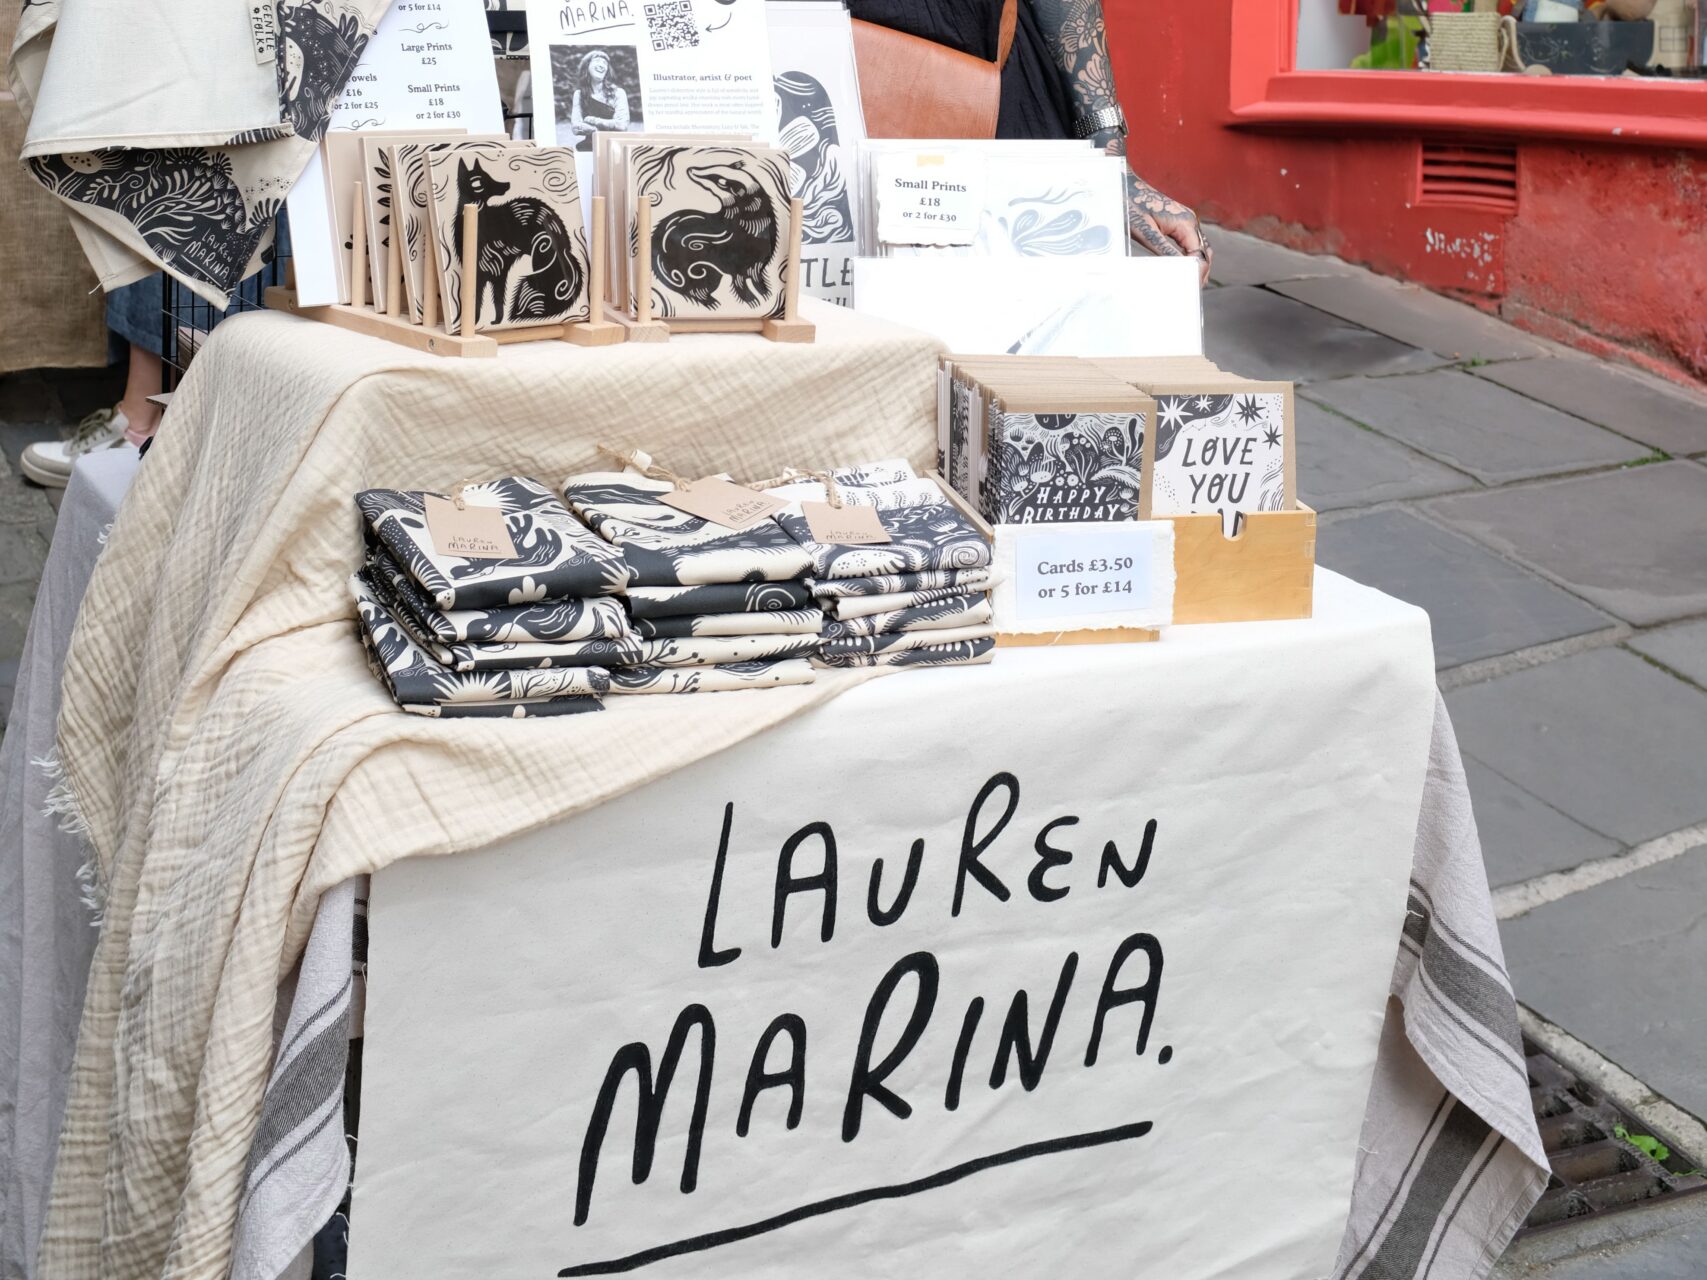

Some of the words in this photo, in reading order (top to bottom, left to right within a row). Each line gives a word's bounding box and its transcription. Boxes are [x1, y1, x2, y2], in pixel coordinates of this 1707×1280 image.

[414, 3, 425, 11] for
[427, 3, 441, 11] £14
[262, 4, 275, 51] GENTLE
[401, 43, 425, 53] Large
[427, 42, 453, 52] Prints
[421, 57, 437, 65] £25
[347, 73, 378, 82] owels
[653, 73, 698, 82] Illustrator,
[699, 73, 722, 81] artist
[724, 73, 732, 81] &
[734, 74, 753, 83] poet
[346, 88, 363, 97] £16
[407, 84, 432, 93] Small
[434, 84, 461, 92] Prints
[344, 102, 349, 110] 2
[351, 101, 362, 109] for
[364, 101, 379, 109] £25
[428, 98, 444, 107] £18
[433, 111, 445, 119] for
[447, 111, 461, 119] £30
[894, 177, 928, 189] Small
[932, 180, 967, 192] Prints
[919, 197, 941, 207] £18
[923, 211, 937, 220] for
[939, 213, 957, 222] £30
[202, 227, 233, 263] LAUREN
[1036, 486, 1108, 504] HAPPY
[1021, 503, 1121, 525] BIRTHDAY
[1037, 559, 1084, 575] Cards
[1088, 557, 1133, 572] £3.50
[1038, 587, 1056, 599] or
[1060, 585, 1070, 599] 5
[1075, 582, 1098, 596] for
[1102, 579, 1133, 593] £14
[698, 771, 1158, 968] LAUREN
[573, 932, 1173, 1227] MARINA.
